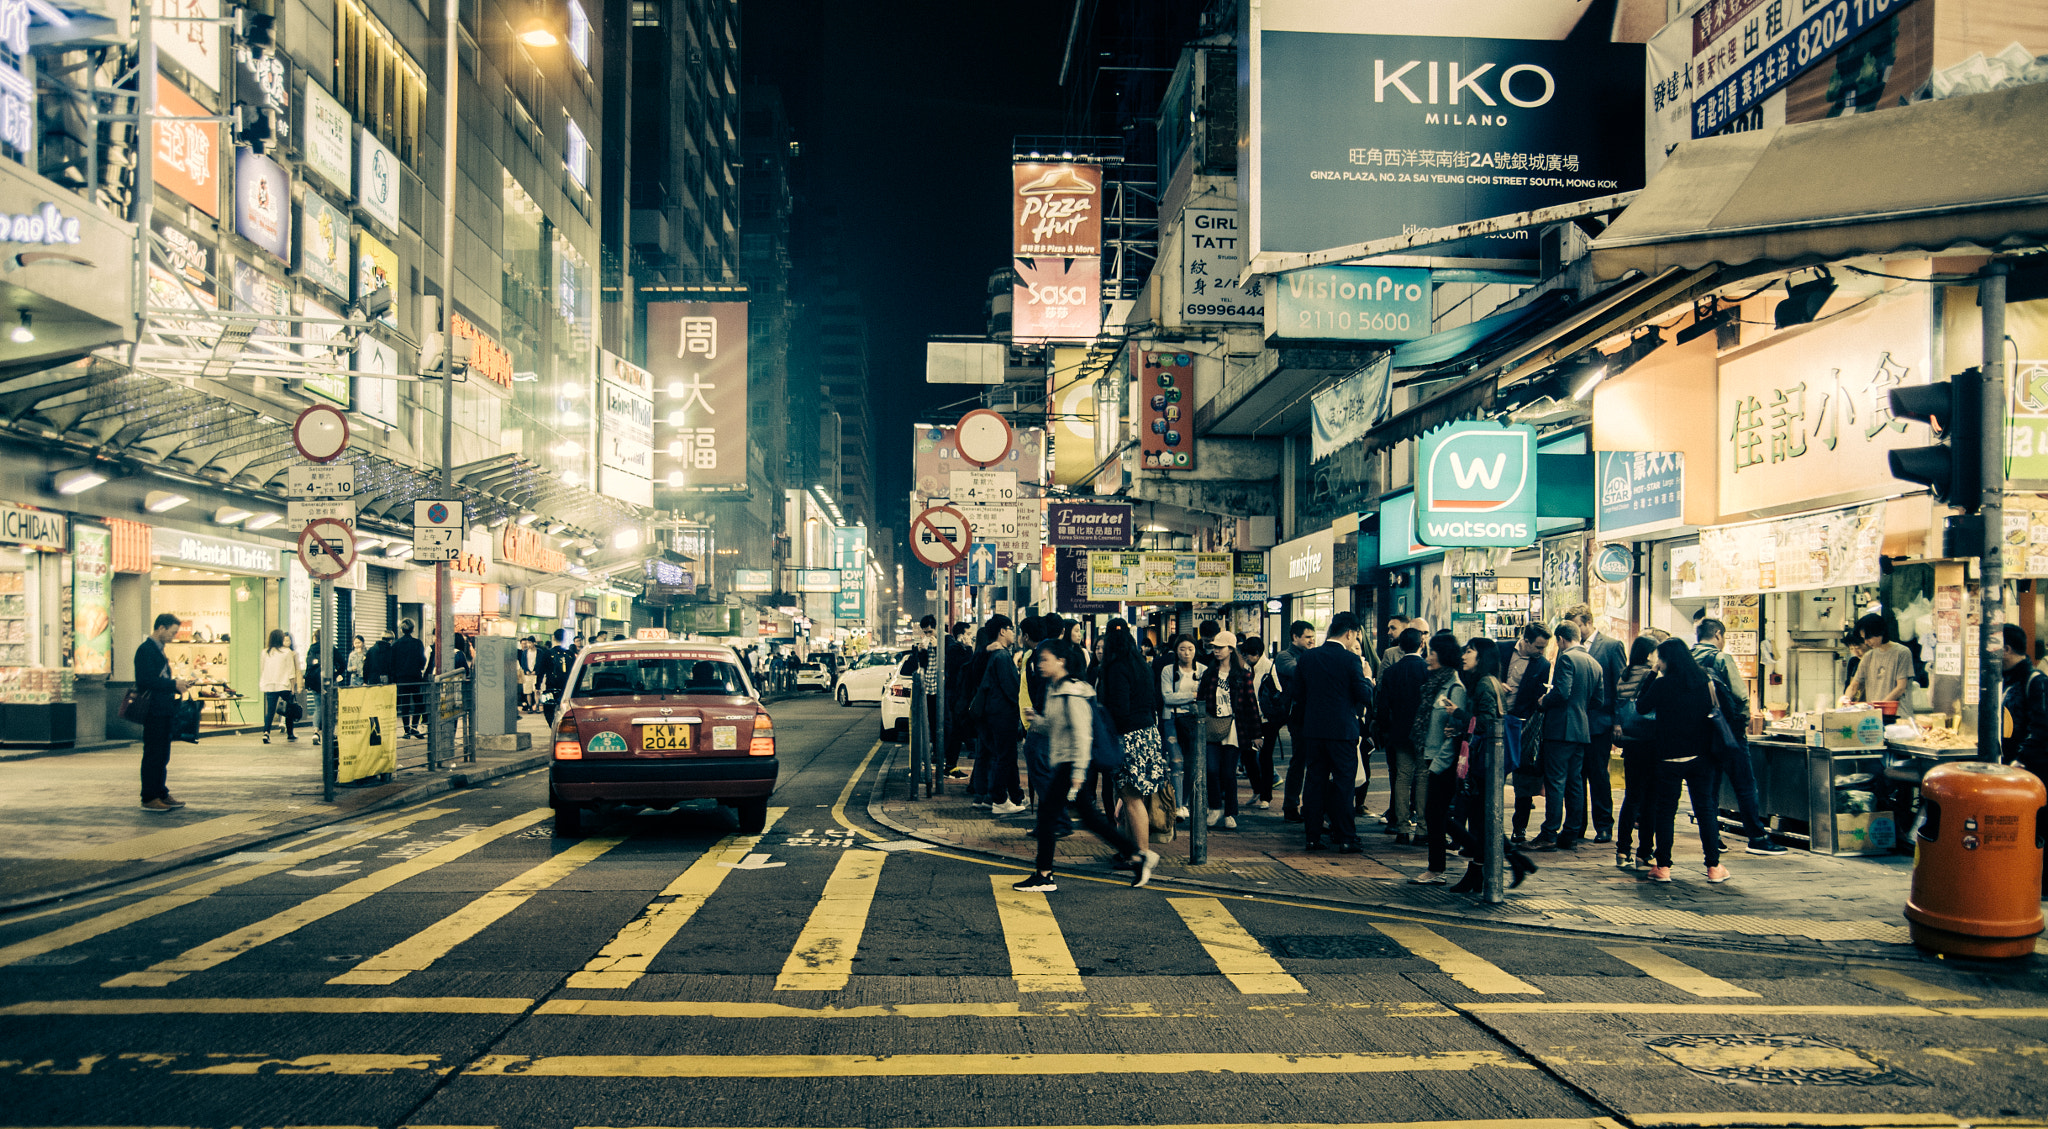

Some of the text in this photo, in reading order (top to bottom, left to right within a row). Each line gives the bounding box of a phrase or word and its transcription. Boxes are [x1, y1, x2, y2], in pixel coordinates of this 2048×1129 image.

[1798, 1, 1848, 66] 8202
[1374, 59, 1556, 108] KIKO
[1425, 113, 1508, 126] MILANO
[1350, 148, 1580, 172] 旺角西洋菜南街2A號銀城廣場
[1310, 171, 1618, 188] GINZA PLAZA, NO. 2A SAI YEUNG CHOI STREET SOUTH, MONG KOK
[1020, 193, 1092, 226] Pizza
[1032, 213, 1088, 243] Hut
[1195, 215, 1237, 229] GIRL
[1047, 245, 1066, 253] Pizza
[1075, 245, 1095, 253] More
[1191, 259, 1208, 295] 紋身
[1214, 278, 1239, 288] 2/F
[1289, 274, 1422, 301] VisionPro
[1187, 304, 1264, 316] 69996444
[1299, 311, 1410, 331] 2110 5600
[677, 316, 718, 469] 周大福
[1731, 351, 1910, 474] 佳記小食
[338, 482, 350, 492] 10
[1608, 480, 1626, 492] HOT
[1633, 481, 1660, 494] HOT-STAR
[1000, 489, 1013, 498] 10
[1604, 490, 1629, 504] STAR
[1058, 509, 1123, 526] Emarket
[2, 510, 60, 543] ICHIBAN
[1002, 524, 1014, 533] 10
[1427, 520, 1528, 538] watsons
[445, 530, 452, 541] 7
[445, 549, 459, 559] 12
[1289, 545, 1322, 582] innisfree
[641, 630, 666, 638] TAXI
[656, 726, 676, 736] KW
[604, 738, 611, 746] 5
[645, 737, 687, 748] 2044
